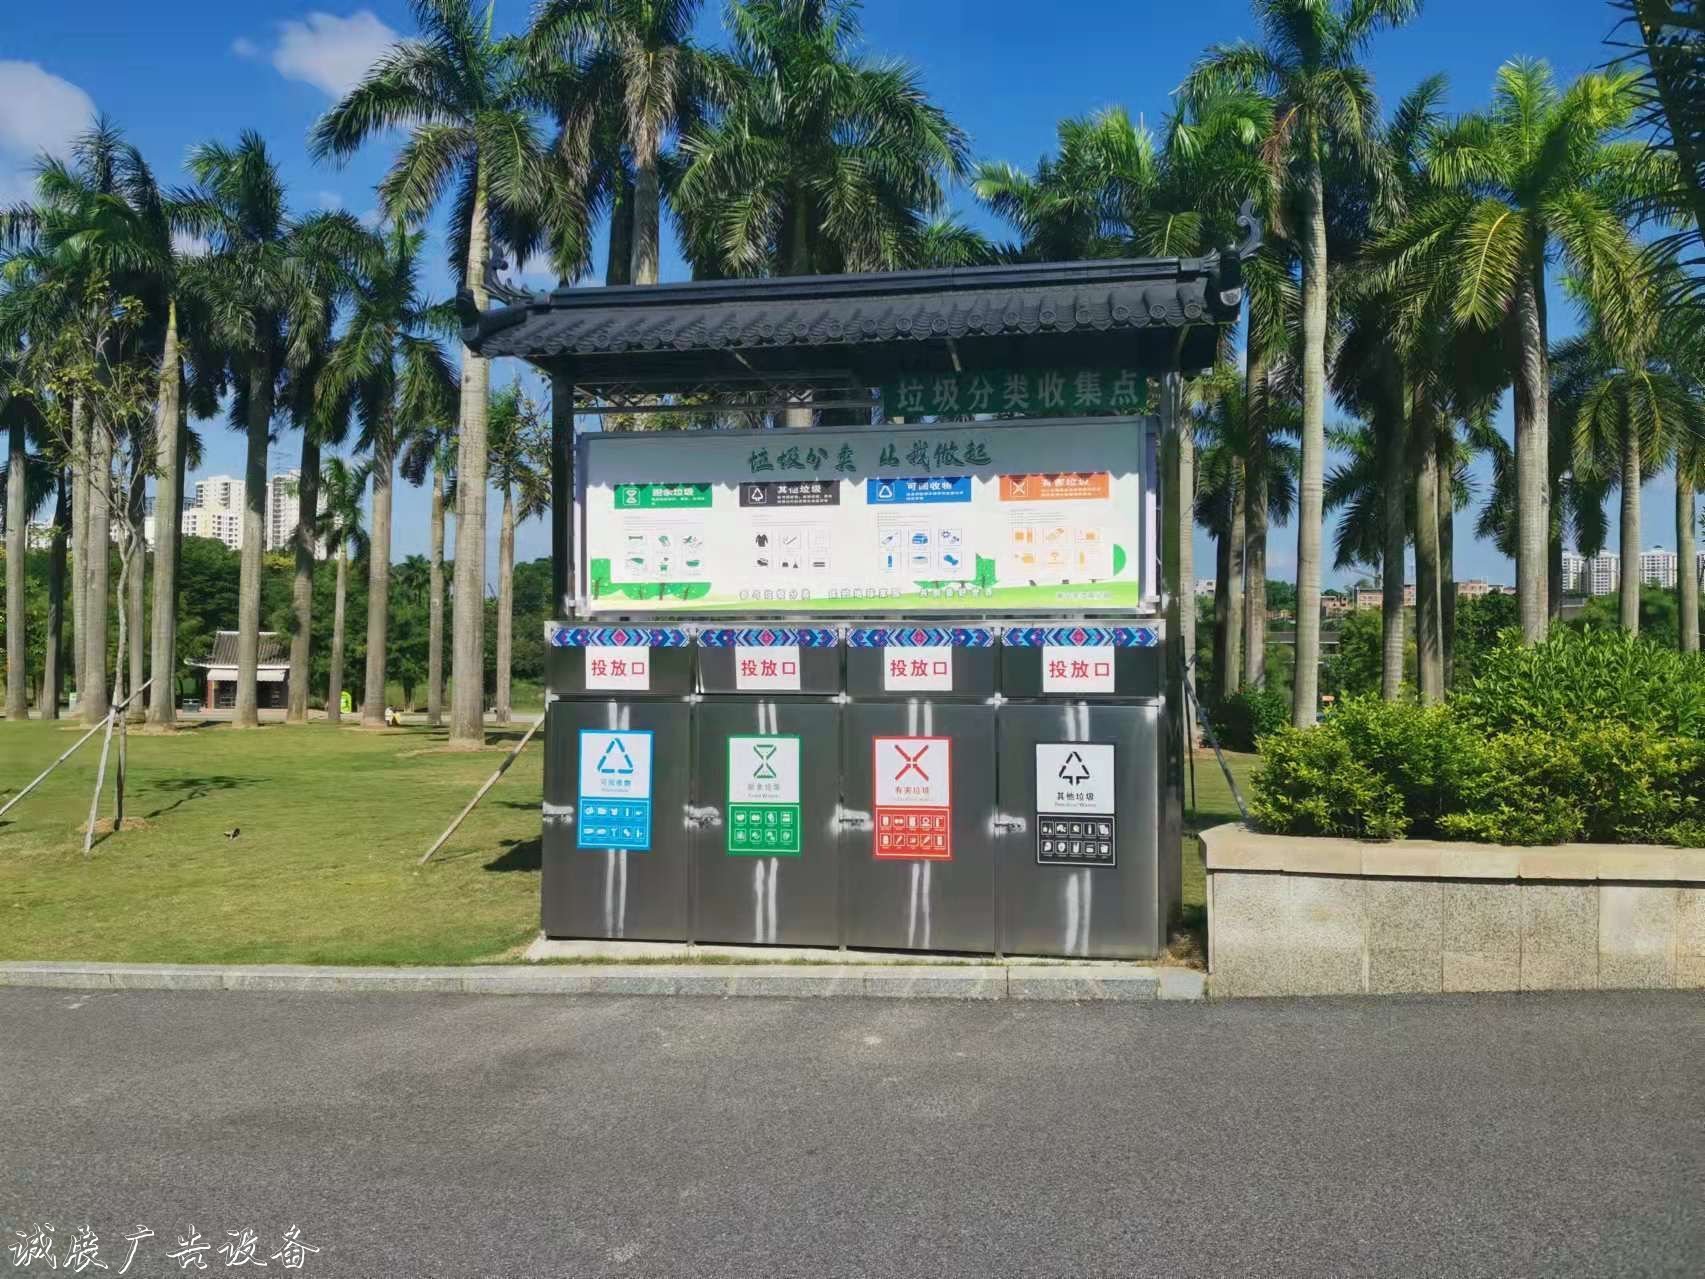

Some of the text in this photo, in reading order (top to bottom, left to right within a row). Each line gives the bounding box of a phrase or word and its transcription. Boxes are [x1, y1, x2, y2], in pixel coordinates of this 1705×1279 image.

[896, 370, 1138, 412] 垃圾分类收集点
[749, 443, 857, 473] 垃圾分类
[591, 659, 645, 676] 投放口
[741, 659, 796, 676] 投放口
[890, 659, 948, 677] 投放口
[1049, 661, 1110, 678] 投放口
[1057, 791, 1095, 801] 其他垃圾
